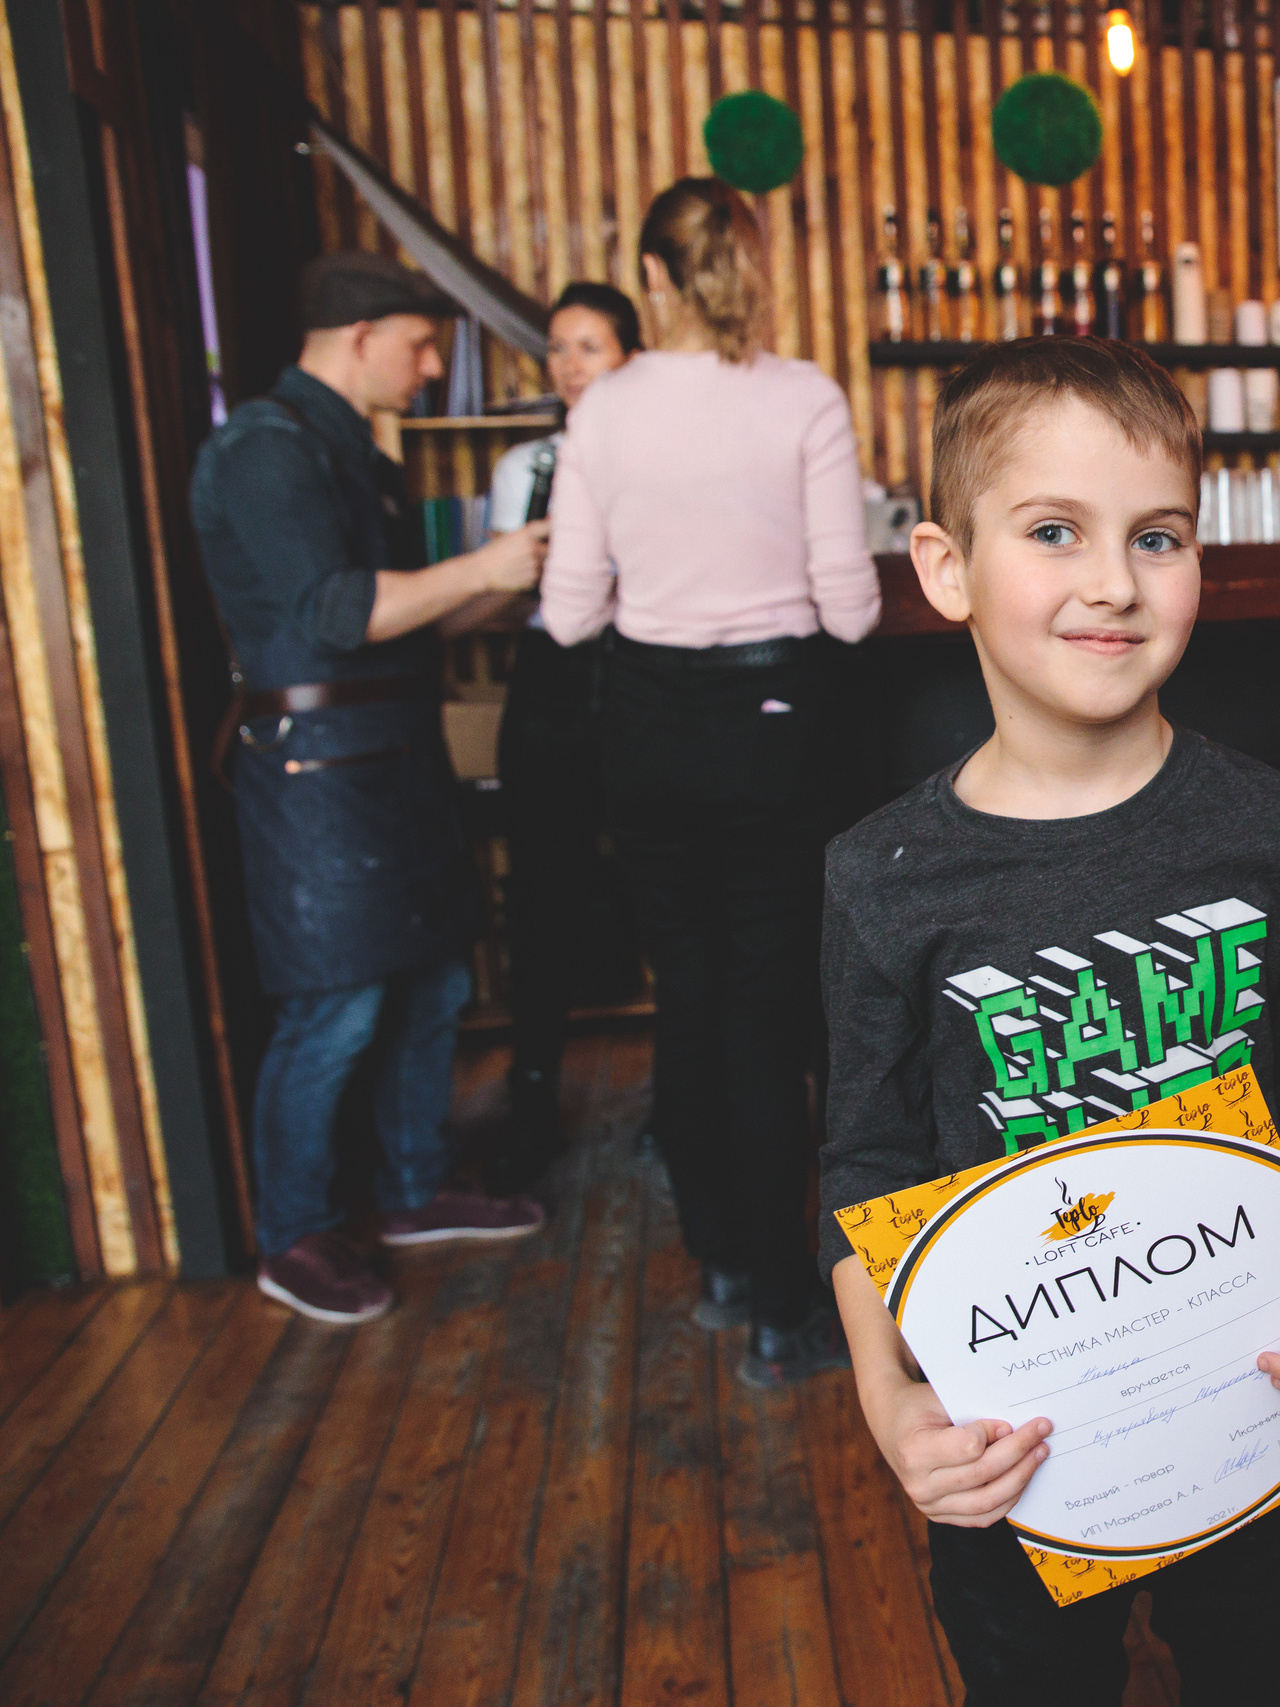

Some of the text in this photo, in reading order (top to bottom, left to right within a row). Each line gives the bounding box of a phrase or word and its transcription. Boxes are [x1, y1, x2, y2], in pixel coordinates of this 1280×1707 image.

[942, 897, 1268, 1099] GAME
[1050, 1197, 1100, 1232] Teplo
[1033, 1221, 1134, 1266] LOFT CAFE
[968, 1204, 1256, 1353] ДИПЛОМ
[1001, 1335, 1103, 1377] УЧАСТНИКА
[1104, 1308, 1170, 1346] МАСТЕР
[1186, 1271, 1257, 1310] КЛАССА
[1120, 1363, 1191, 1398] вручается
[1064, 1485, 1121, 1511] Ведущий
[1133, 1463, 1175, 1486] повар
[1080, 1523, 1102, 1539] ИП
[1104, 1497, 1173, 1530] Махраева
